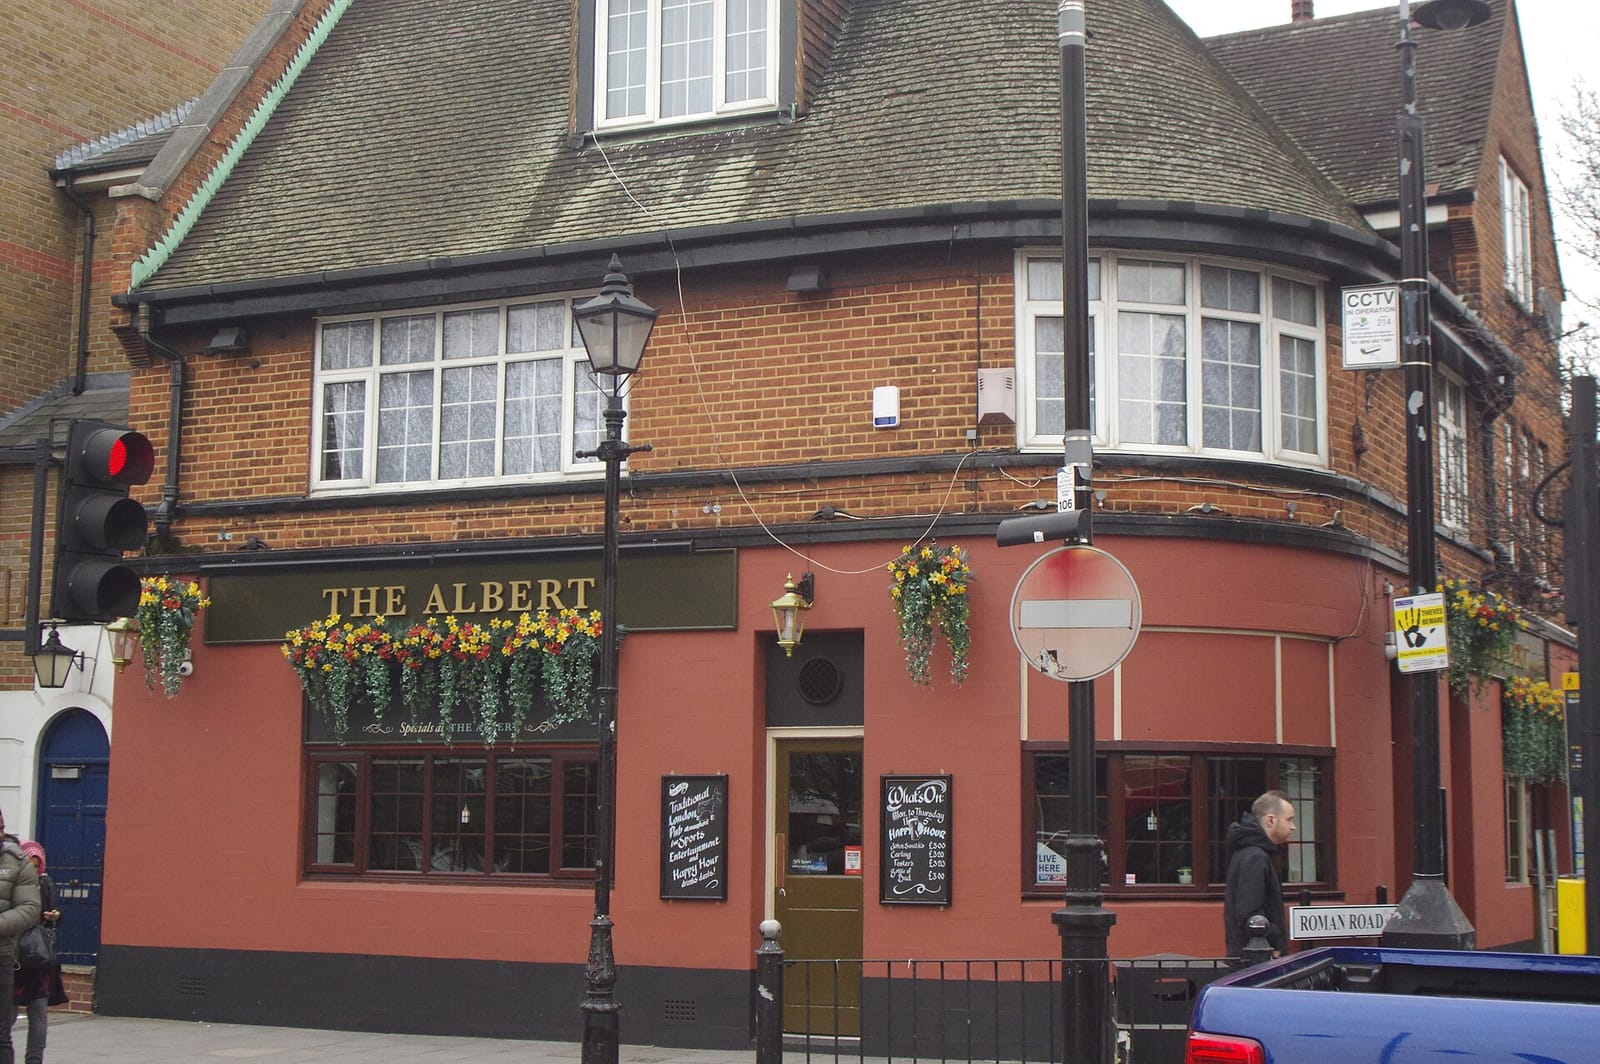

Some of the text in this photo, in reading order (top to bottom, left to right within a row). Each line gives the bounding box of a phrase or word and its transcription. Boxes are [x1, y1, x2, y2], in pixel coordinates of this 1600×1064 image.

[1347, 291, 1394, 308] CCTV
[1355, 306, 1395, 315] OPERATION
[1059, 499, 1073, 510] 106
[322, 577, 596, 618] THE ALBERT
[450, 723, 472, 732] THE
[669, 785, 710, 814] Traditional
[668, 808, 698, 827] London
[914, 807, 945, 824] Thursday
[669, 824, 683, 839] Pub
[677, 830, 705, 849] Sports
[923, 826, 947, 840] HOUR
[669, 836, 720, 863] Entertainment
[672, 855, 719, 881] Happy Hour
[1039, 864, 1060, 872] HERE
[1300, 913, 1384, 932] ROMAN ROAD
